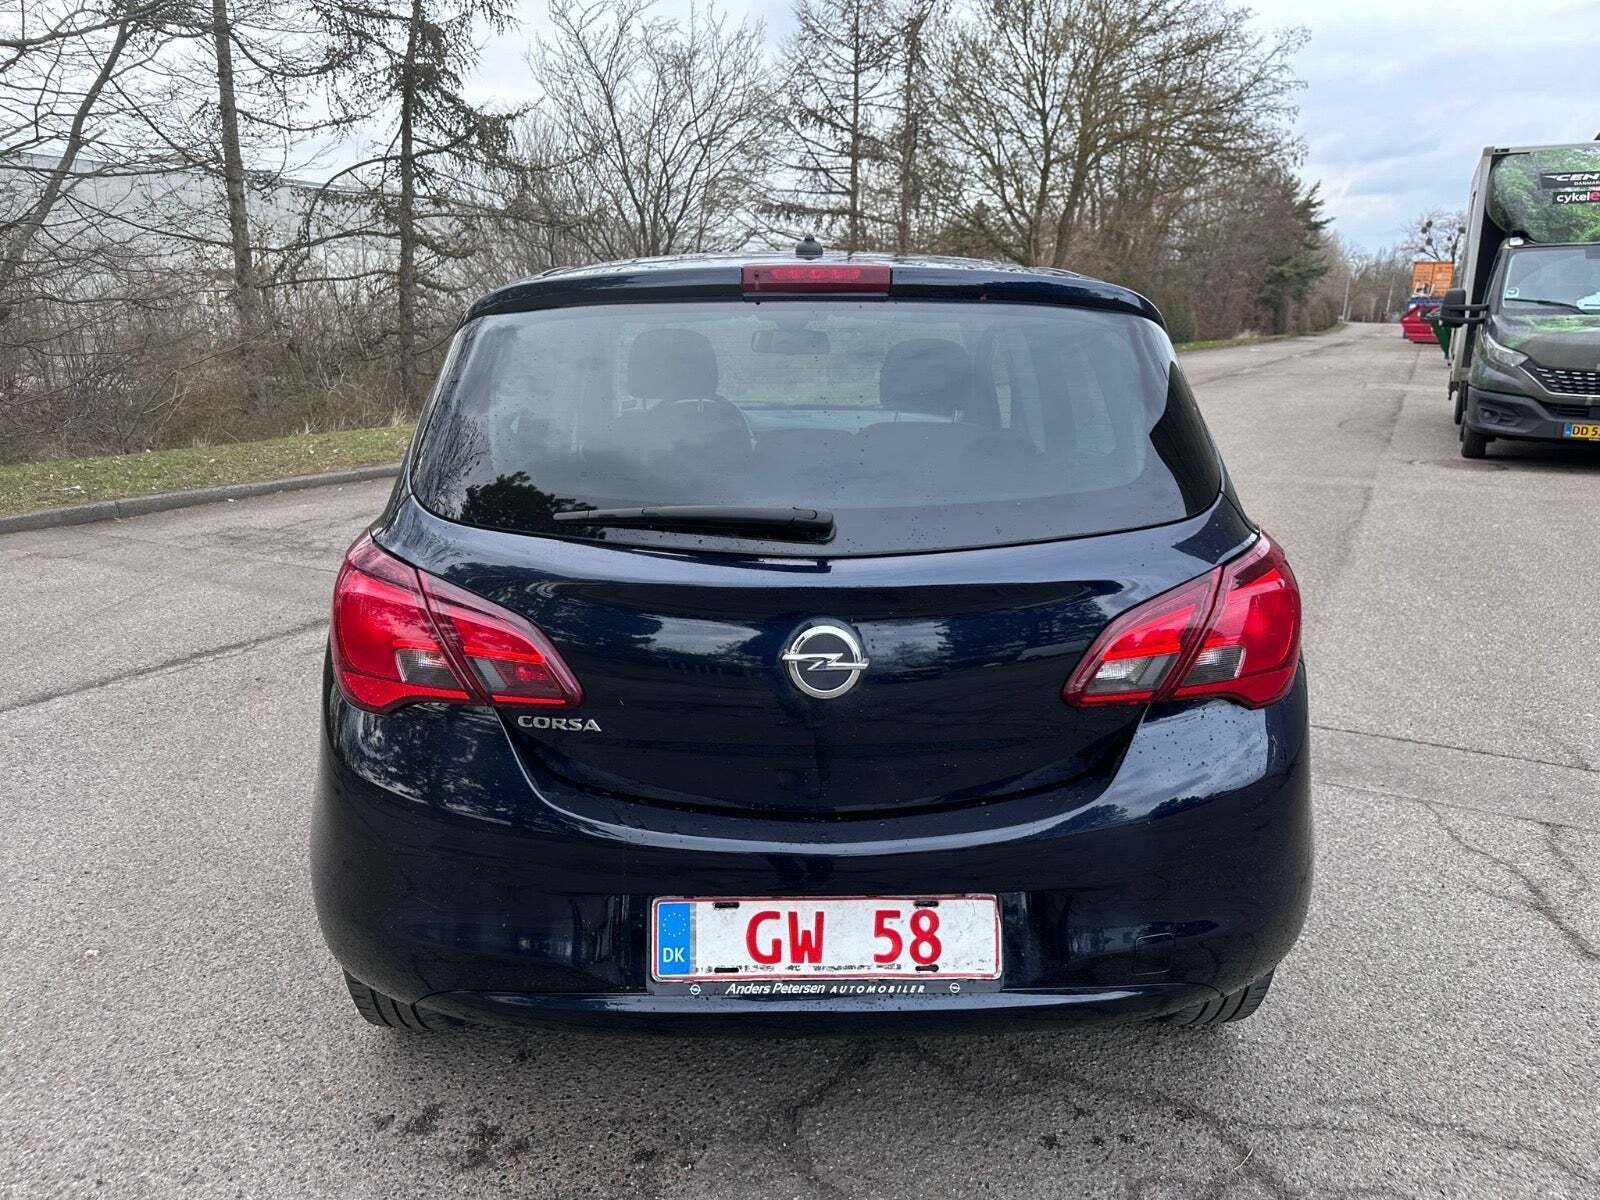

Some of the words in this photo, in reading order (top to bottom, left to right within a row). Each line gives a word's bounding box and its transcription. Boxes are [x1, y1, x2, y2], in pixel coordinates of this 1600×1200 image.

[1572, 425, 1589, 436] DD
[1590, 426, 1600, 437] 5
[517, 715, 602, 732] CORSA
[746, 910, 825, 965] GW
[873, 908, 942, 965] 58
[662, 946, 686, 963] DK
[725, 983, 770, 995] Anders
[772, 982, 826, 994] Petersen
[830, 984, 925, 994] AUTOMOBILER
